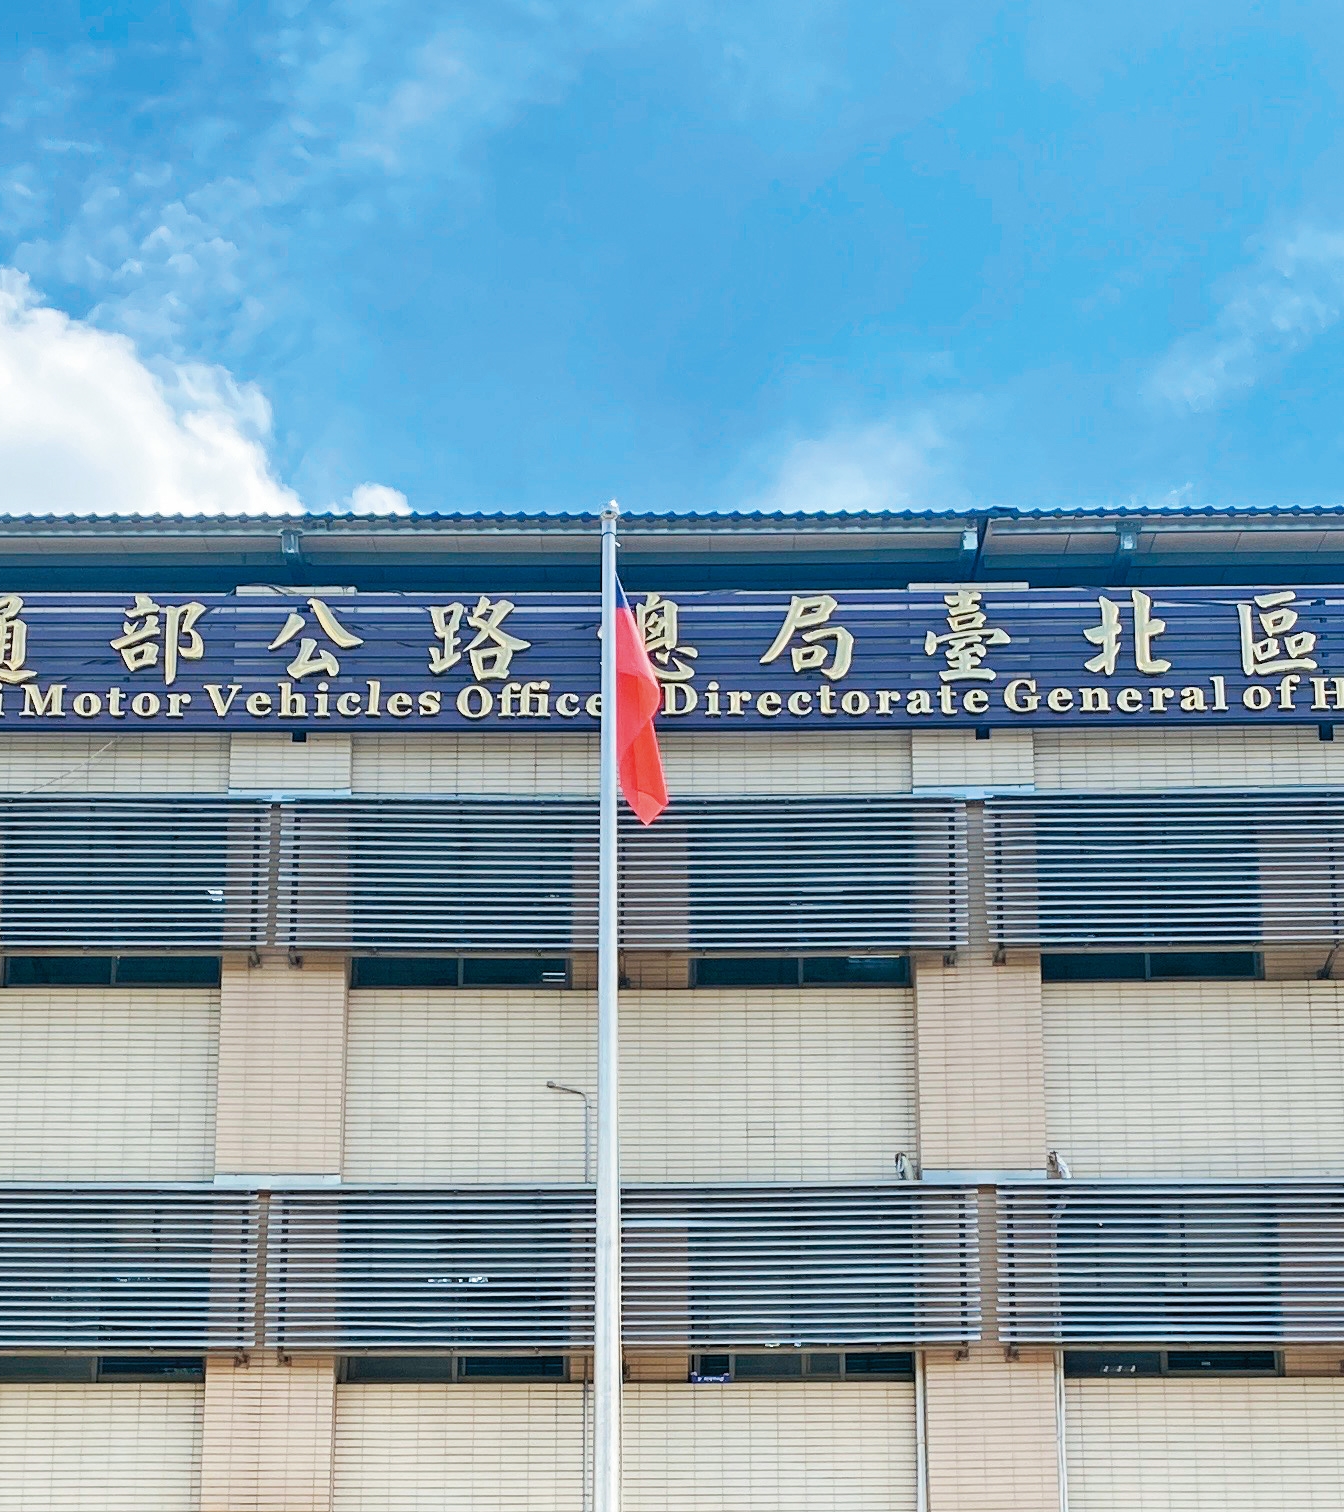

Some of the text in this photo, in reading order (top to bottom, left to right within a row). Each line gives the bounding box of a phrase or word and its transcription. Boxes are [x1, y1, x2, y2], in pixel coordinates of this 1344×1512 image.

[19, 684, 191, 718] Motor
[203, 680, 442, 718] Vehicles
[456, 680, 602, 718] Office
[659, 681, 990, 717] Directorate
[1004, 676, 1229, 715] General
[1242, 674, 1300, 710] of
